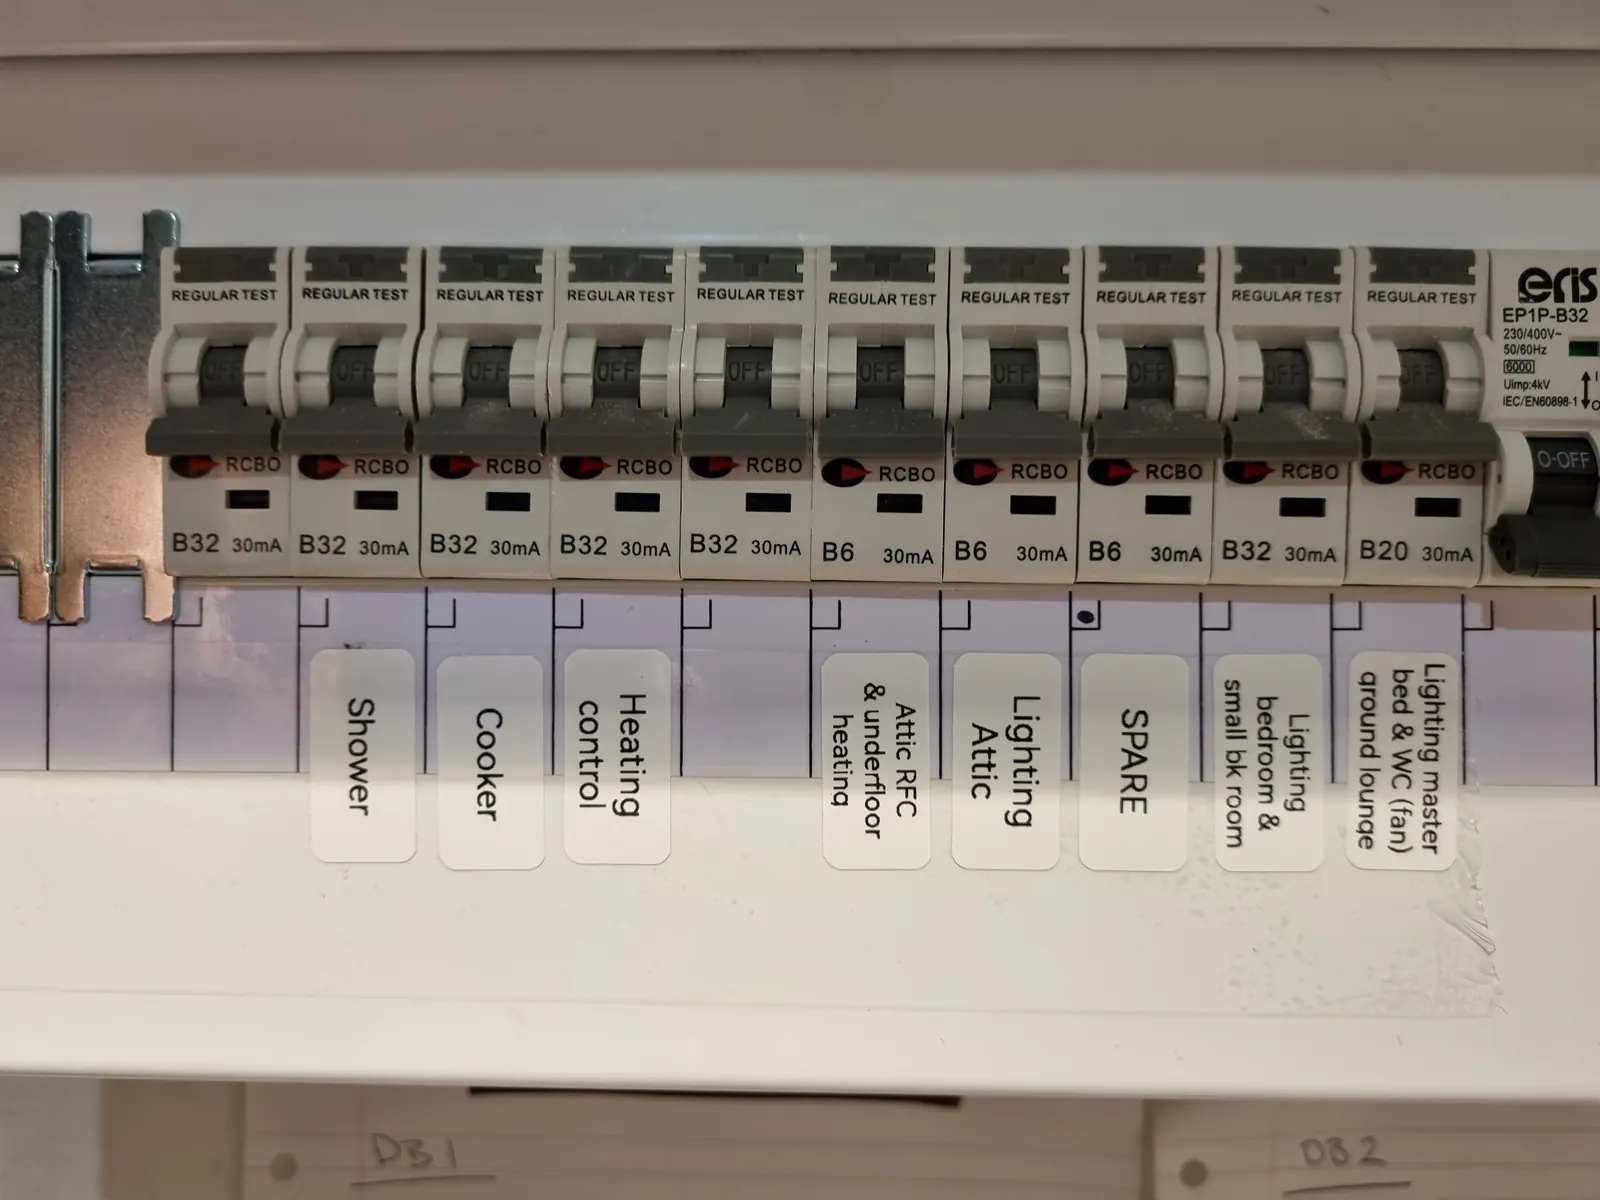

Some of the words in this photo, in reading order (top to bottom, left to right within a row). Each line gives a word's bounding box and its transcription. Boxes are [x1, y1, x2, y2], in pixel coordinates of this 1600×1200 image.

[172, 290, 238, 301] REGULAR
[242, 289, 277, 301] TEST
[302, 288, 369, 300] REGULAR
[373, 289, 408, 301] TEST
[437, 289, 504, 301] REGULAR
[508, 290, 544, 302] TEST
[697, 288, 765, 300] REGULAR
[769, 289, 804, 301] TEST
[1518, 267, 1598, 303] eris
[568, 290, 635, 301] REGULAR
[639, 291, 674, 302] TEST
[829, 292, 896, 305] REGULAR
[901, 294, 936, 305] TEST
[961, 291, 1030, 303] REGULAR
[1034, 292, 1070, 304] TEST
[1097, 291, 1166, 303] REGULAR
[1170, 292, 1206, 304] TEST
[1232, 290, 1301, 302] REGULAR
[1306, 291, 1342, 303] TEST
[1368, 291, 1437, 303] REGULAR
[1441, 293, 1476, 304] TEST
[1503, 308, 1588, 322] EP1P-B32
[1504, 344, 1547, 355] 50/60Hz
[1506, 362, 1532, 372] 6000
[1504, 379, 1550, 392] Uimp:4kV
[227, 457, 280, 472] RCBO
[355, 459, 409, 475] RCBO
[487, 459, 541, 475] RCBO
[618, 459, 672, 475] RCBO
[747, 458, 802, 473] RCBO
[880, 467, 935, 482] RCBO
[1012, 464, 1067, 479] RCBO
[1147, 464, 1202, 480] RCBO
[1283, 464, 1339, 480] RCBO
[1419, 463, 1475, 479] RCBO
[173, 533, 219, 552] B32
[233, 538, 282, 552] 30mA
[300, 534, 346, 555] B32
[360, 541, 409, 555] 30mA
[431, 534, 477, 554] B32
[491, 540, 540, 556] 30mA
[561, 534, 607, 555] B32
[621, 541, 671, 557] 30mA
[691, 533, 737, 554] B32
[751, 540, 801, 555] 30mA
[823, 542, 854, 562] B6
[884, 548, 933, 564] 30mA
[955, 540, 986, 561] B6
[1017, 546, 1067, 561] 30mA
[1089, 541, 1121, 561] B6
[1151, 547, 1202, 562] 30mA
[1223, 540, 1271, 561] B32
[1285, 547, 1336, 562] 30mA
[1360, 540, 1408, 561] B20
[1422, 547, 1473, 562] 30mA
[864, 683, 885, 701] &
[1392, 670, 1414, 714] bed
[1225, 680, 1247, 739] small
[1358, 672, 1381, 758] ground
[1417, 664, 1445, 762] Lighting
[896, 703, 916, 760] Attic
[1392, 723, 1413, 741] &
[348, 698, 375, 816] Shower
[579, 701, 606, 808] control
[612, 695, 646, 816] Heating
[831, 715, 854, 806] heating
[1257, 697, 1278, 803] bedroom
[477, 709, 504, 822] Cooker
[971, 723, 998, 799] Attic
[1004, 696, 1040, 827] Lighting
[1120, 709, 1148, 814] SPARE
[1226, 750, 1247, 778] bk
[1283, 715, 1311, 811] Lighting
[1392, 749, 1412, 789] WC
[864, 710, 886, 839] underfloor
[896, 770, 917, 817] RFC
[1227, 787, 1242, 848] room
[1356, 768, 1381, 849] lounge
[1422, 772, 1442, 854] master
[1258, 814, 1280, 830] &
[1387, 799, 1413, 853] (fan)
